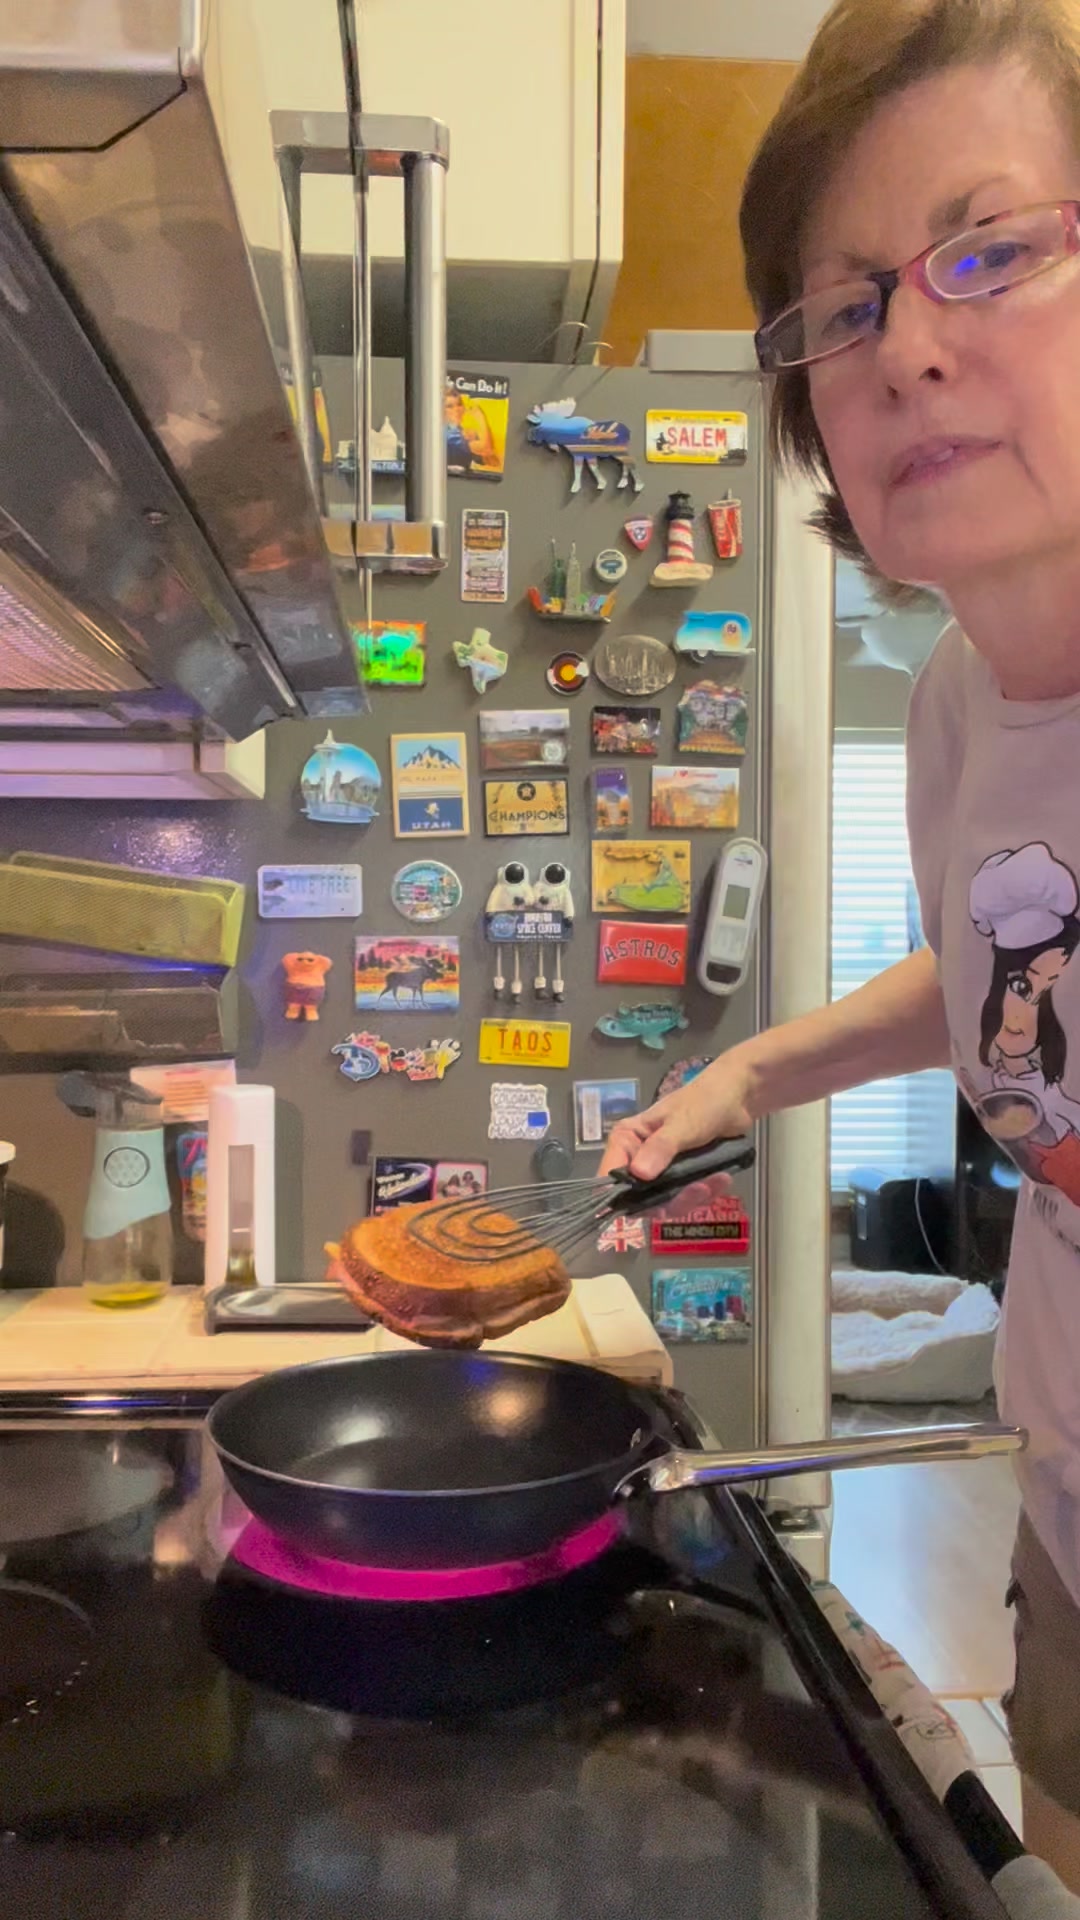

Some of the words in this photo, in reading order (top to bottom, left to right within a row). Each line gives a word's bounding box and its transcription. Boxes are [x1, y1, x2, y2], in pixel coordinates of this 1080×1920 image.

[455, 377, 477, 393] Can
[477, 379, 494, 394] Do
[667, 426, 727, 448] SALEM
[411, 821, 452, 830] UTAH
[488, 809, 566, 823] CHAMPIONS
[603, 939, 681, 967] ASTROS
[498, 1028, 553, 1053] TAOS
